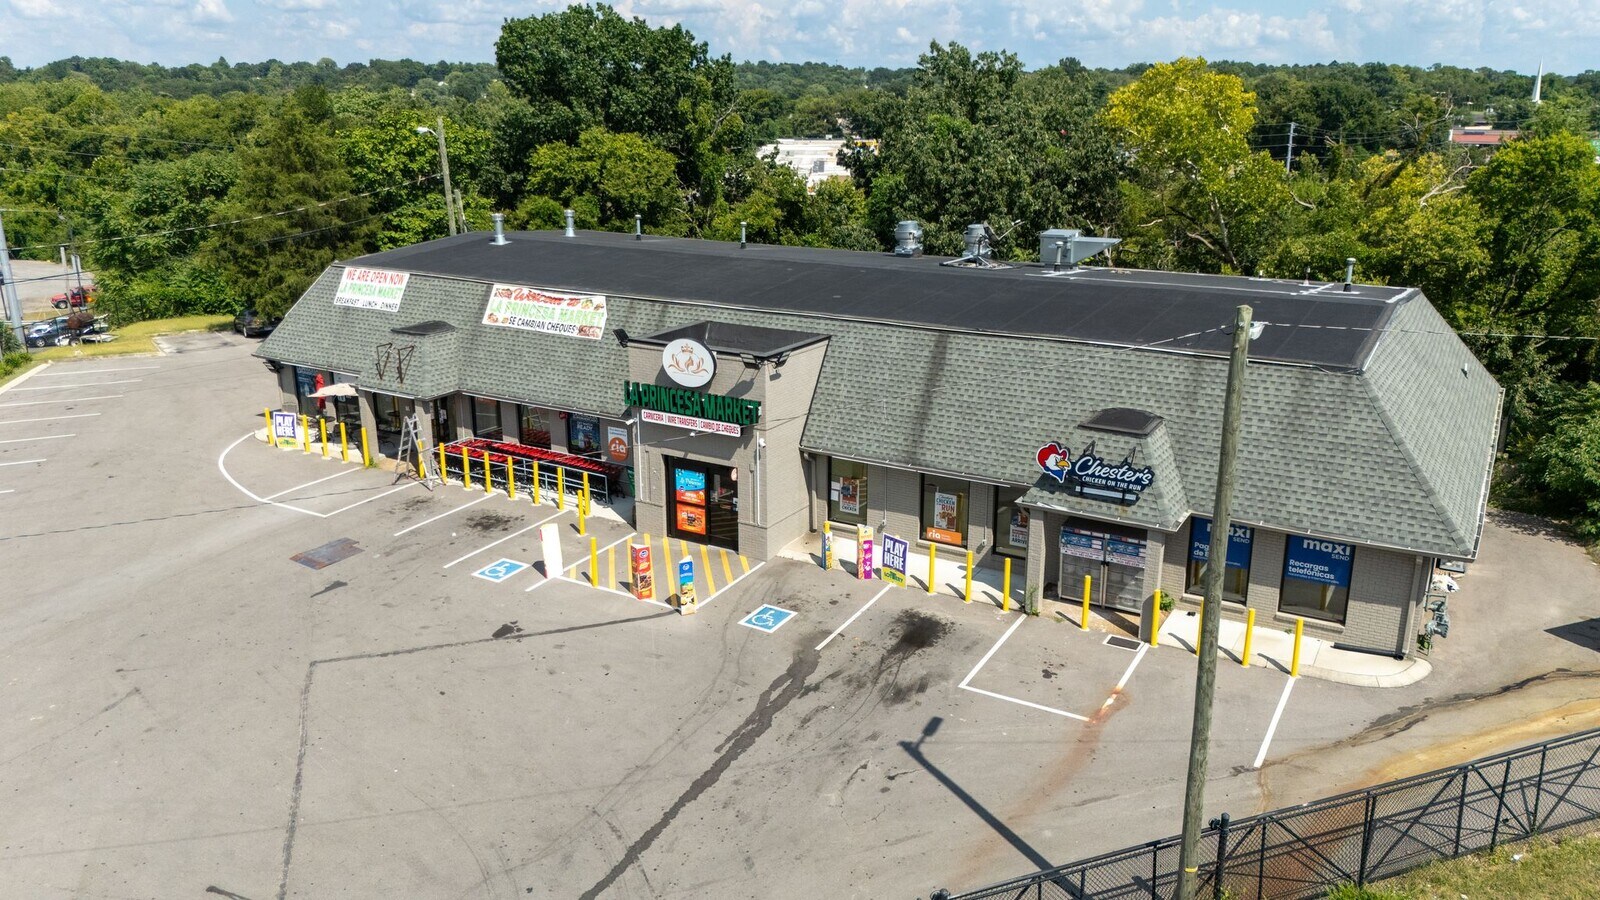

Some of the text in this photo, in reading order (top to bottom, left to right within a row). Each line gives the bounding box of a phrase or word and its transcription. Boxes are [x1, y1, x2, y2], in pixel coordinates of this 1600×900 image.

[347, 269, 405, 286] WE ARE OPEN NOW
[349, 282, 377, 297] PRINCESA
[378, 284, 404, 299] MARKET
[335, 296, 360, 306] BREAKFAST
[380, 302, 398, 311] DINNER
[489, 300, 604, 326] LA PRINCESA MARKET
[509, 316, 576, 334] SE CAMBIAN CHEQUES
[624, 380, 761, 426] LA PRINCESA MARKET
[276, 416, 293, 426] PLAY
[676, 416, 698, 428] TRANSFERS
[722, 424, 739, 435] CHEQUES
[277, 426, 294, 437] HERE
[1075, 456, 1152, 485] Chester's
[1082, 476, 1106, 485] CHICKEN
[942, 504, 955, 512] RUN
[928, 530, 941, 540] ria
[885, 538, 905, 554] PLAY
[1303, 539, 1350, 556] maxi
[884, 554, 904, 570] HERE
[1289, 559, 1329, 572] Recargas
[1288, 566, 1335, 580] telefónicas
